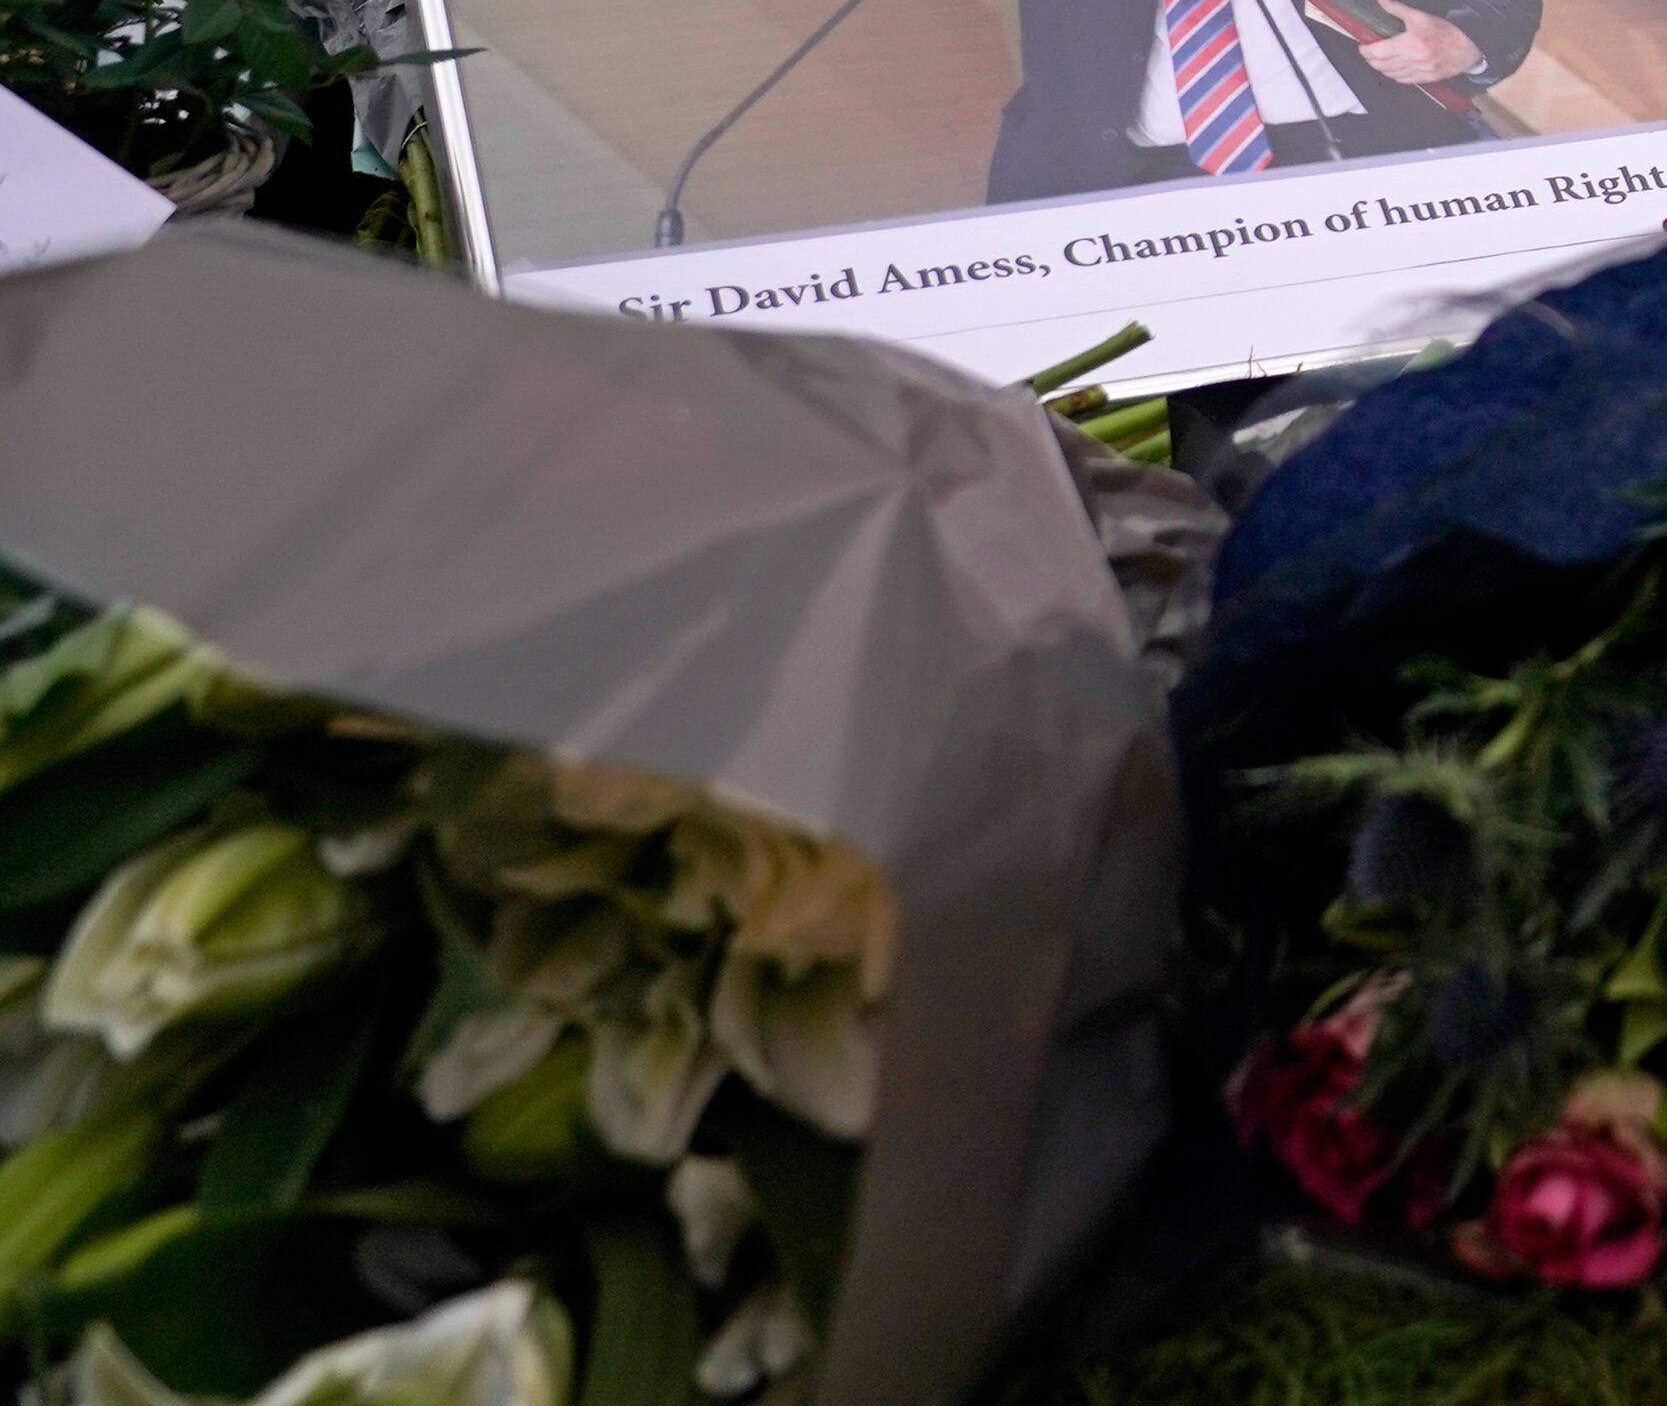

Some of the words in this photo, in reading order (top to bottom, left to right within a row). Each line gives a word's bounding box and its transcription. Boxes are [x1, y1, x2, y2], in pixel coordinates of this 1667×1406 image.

[617, 295, 694, 324] Sir
[706, 267, 863, 319] David
[877, 252, 1050, 296] Amess,
[1064, 211, 1312, 268] Champion
[1325, 199, 1373, 234] of
[1379, 181, 1537, 227] human
